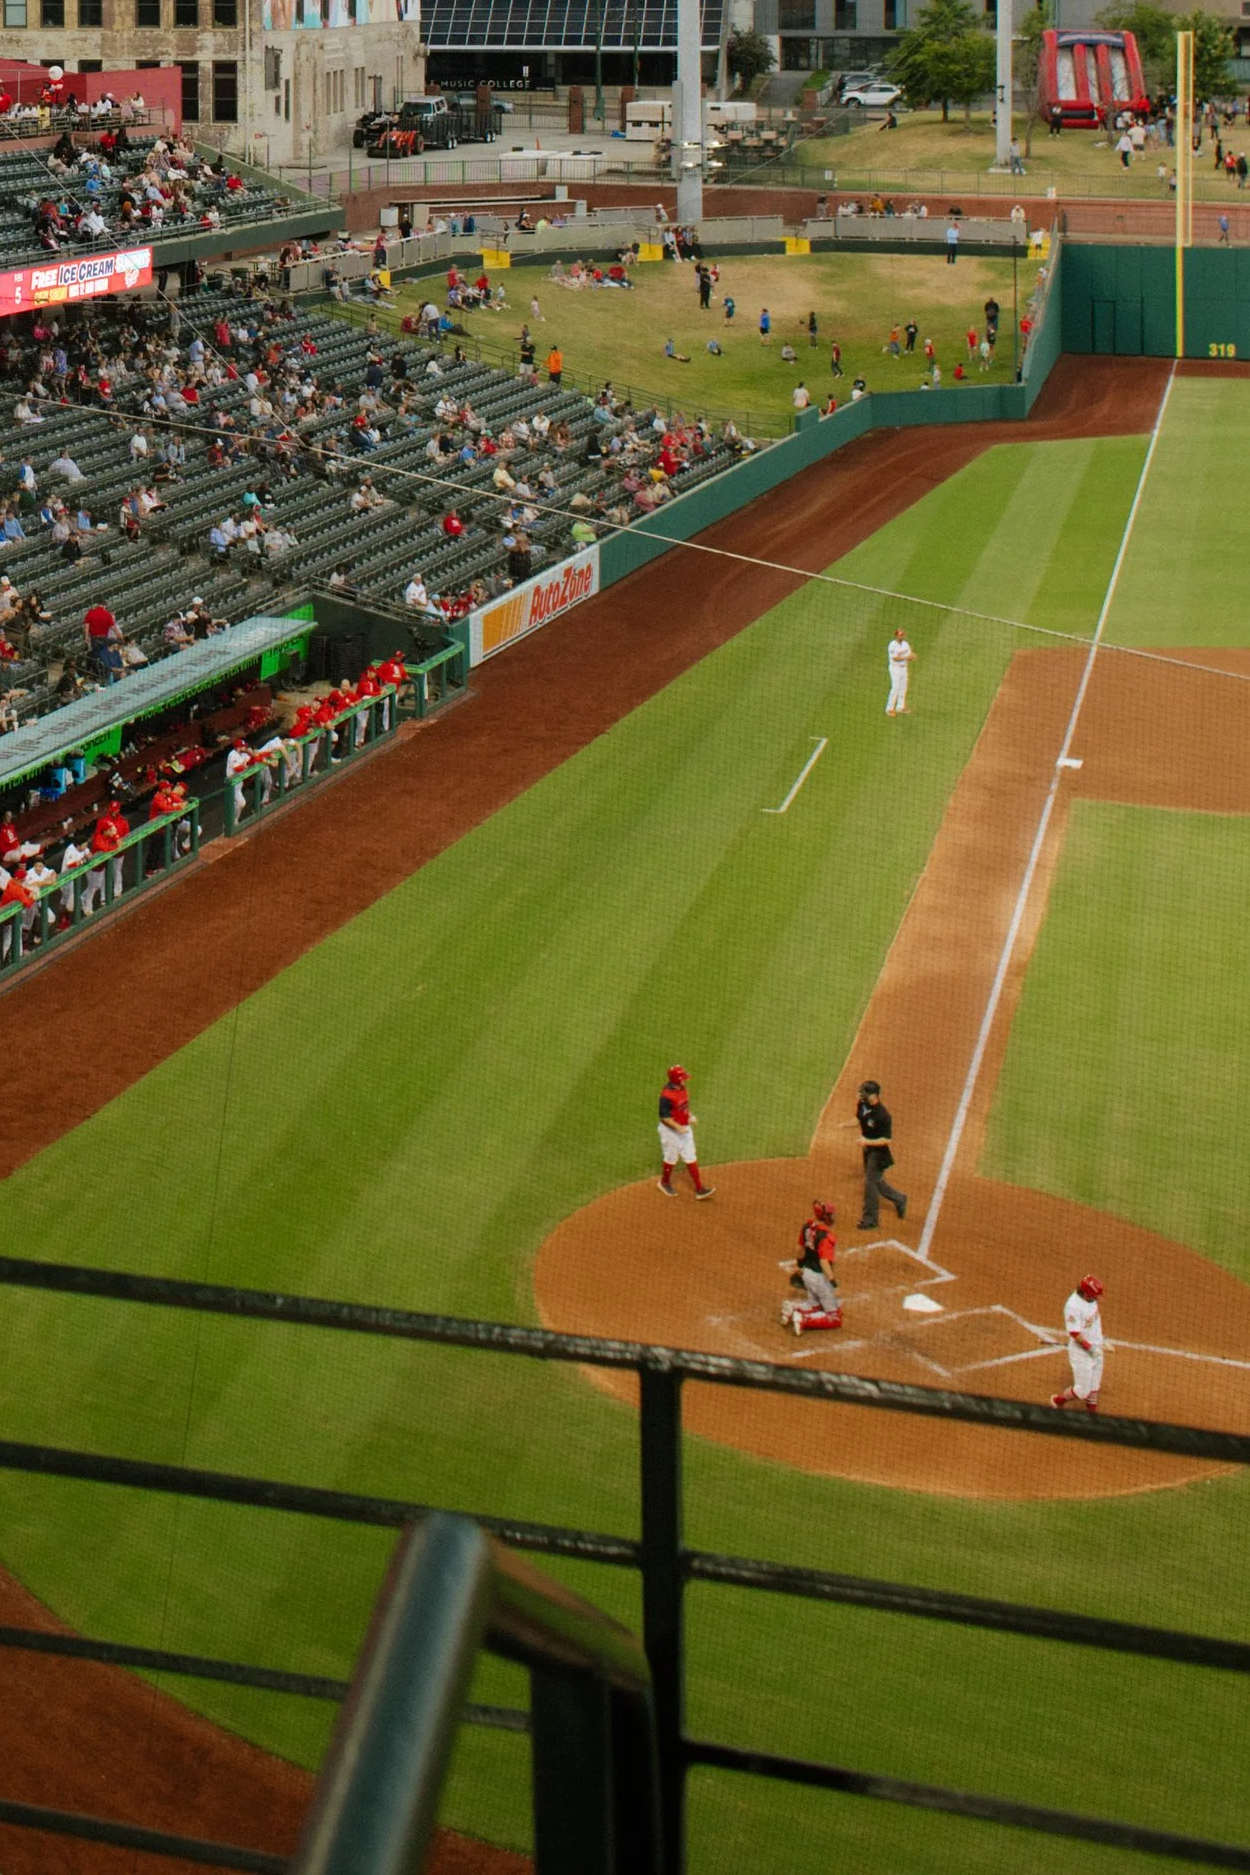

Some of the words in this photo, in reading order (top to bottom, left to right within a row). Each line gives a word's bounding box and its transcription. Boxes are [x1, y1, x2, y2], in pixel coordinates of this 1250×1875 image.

[441, 80, 475, 88] MUSIC
[479, 80, 531, 88] COLLEGE
[13, 273, 24, 283] RBI
[31, 270, 59, 290] FREE
[59, 264, 78, 284] ICE
[78, 256, 115, 280] CREAM
[14, 286, 22, 305] 5
[1208, 342, 1236, 358] 319
[528, 563, 594, 628] AutoZone
[185, 680, 212, 699] LOOKS
